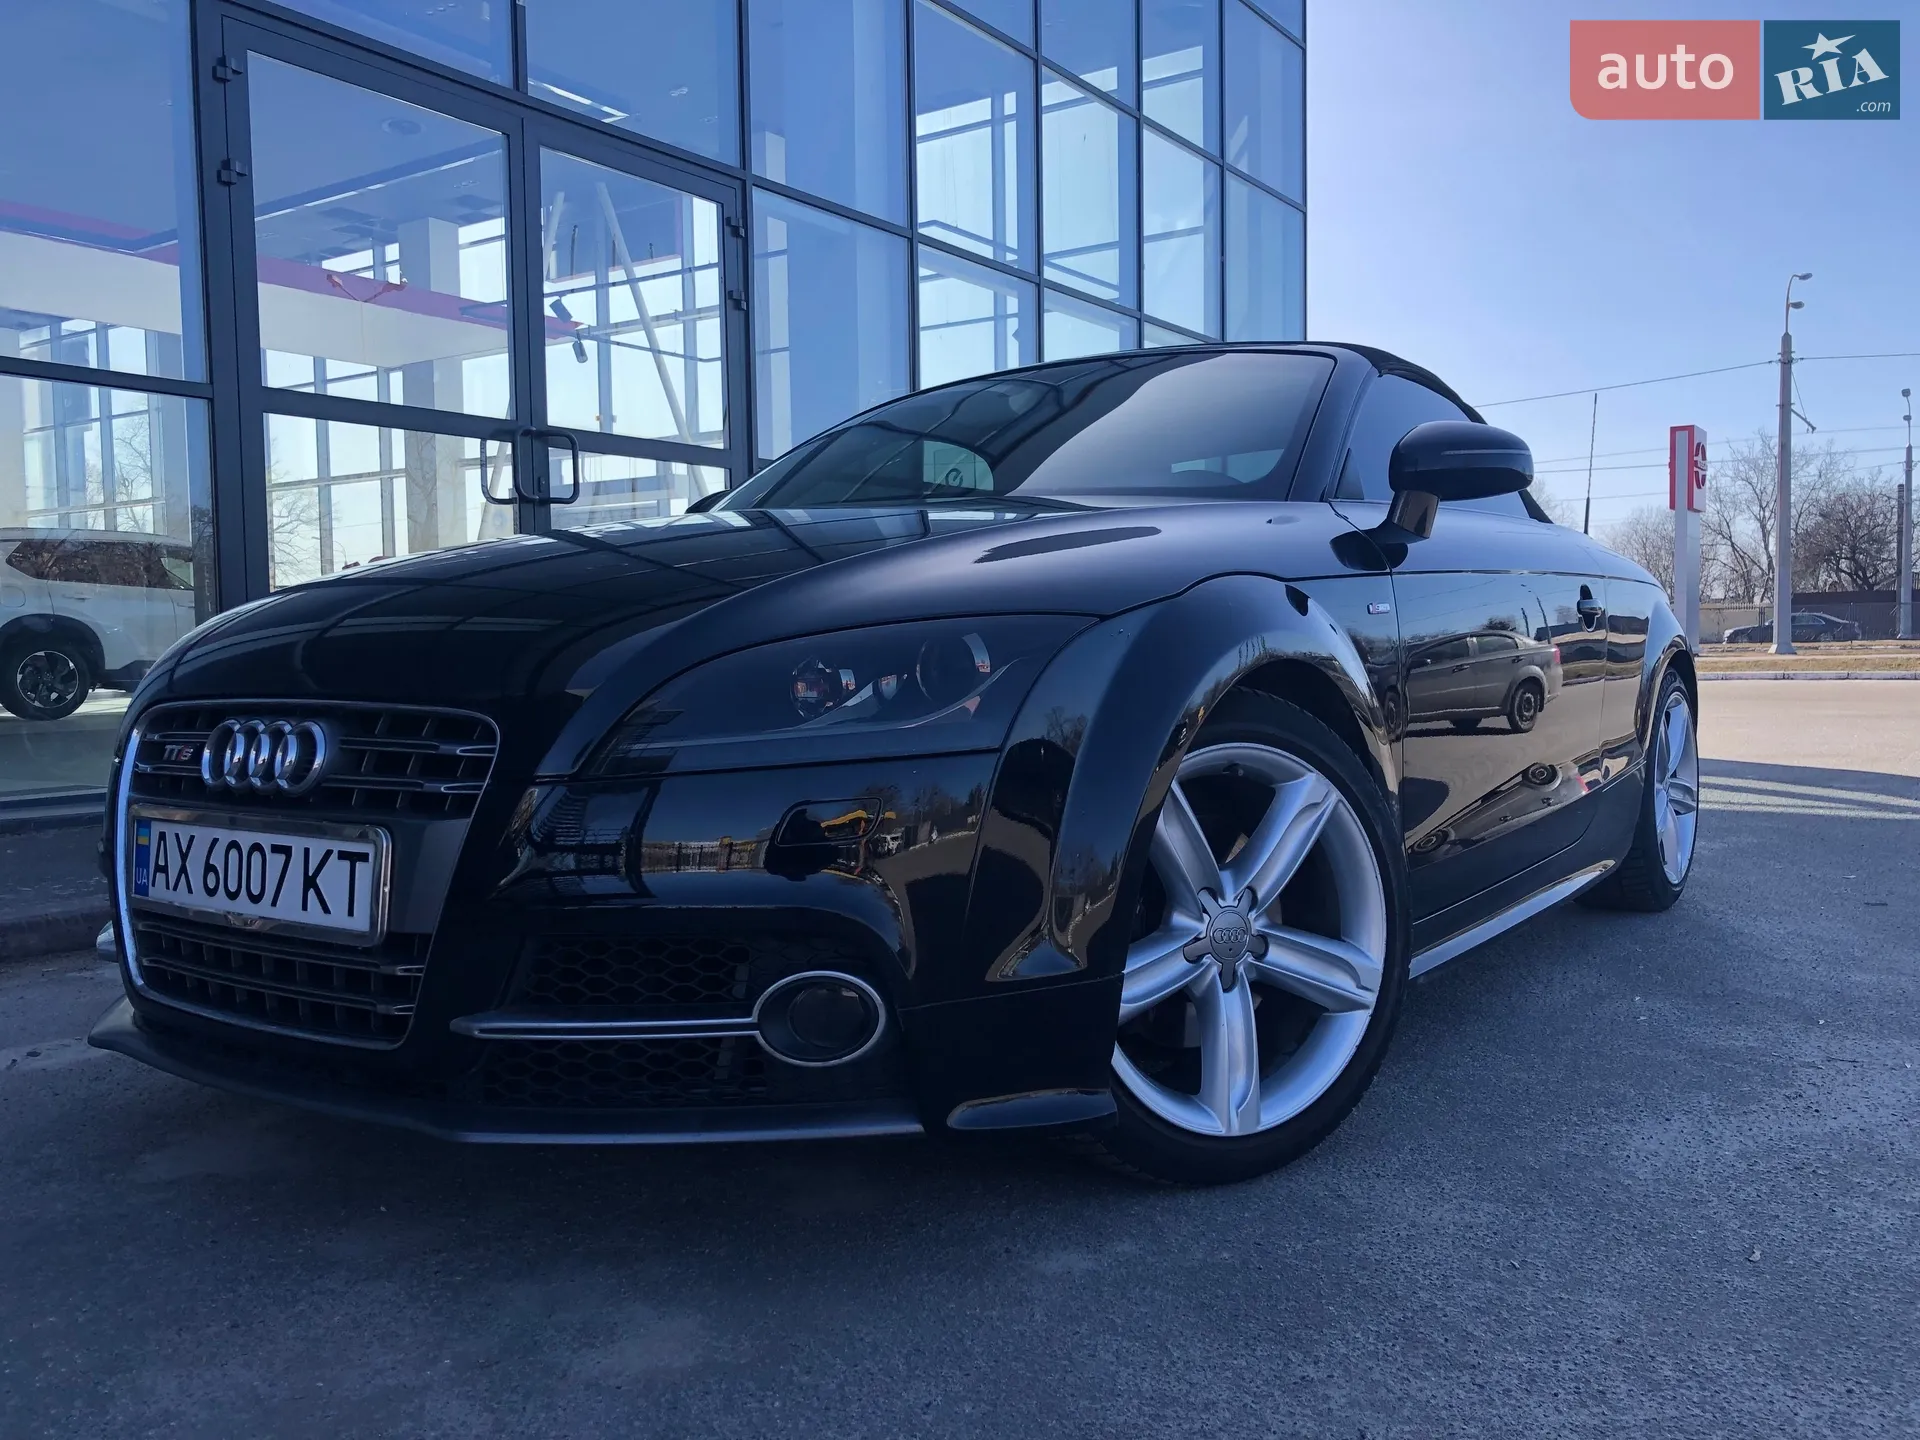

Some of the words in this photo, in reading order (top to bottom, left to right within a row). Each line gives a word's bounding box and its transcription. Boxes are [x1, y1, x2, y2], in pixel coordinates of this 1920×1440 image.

[135, 867, 148, 886] UA
[151, 831, 196, 895] AX
[202, 837, 293, 908] 6007
[301, 846, 370, 918] KT
